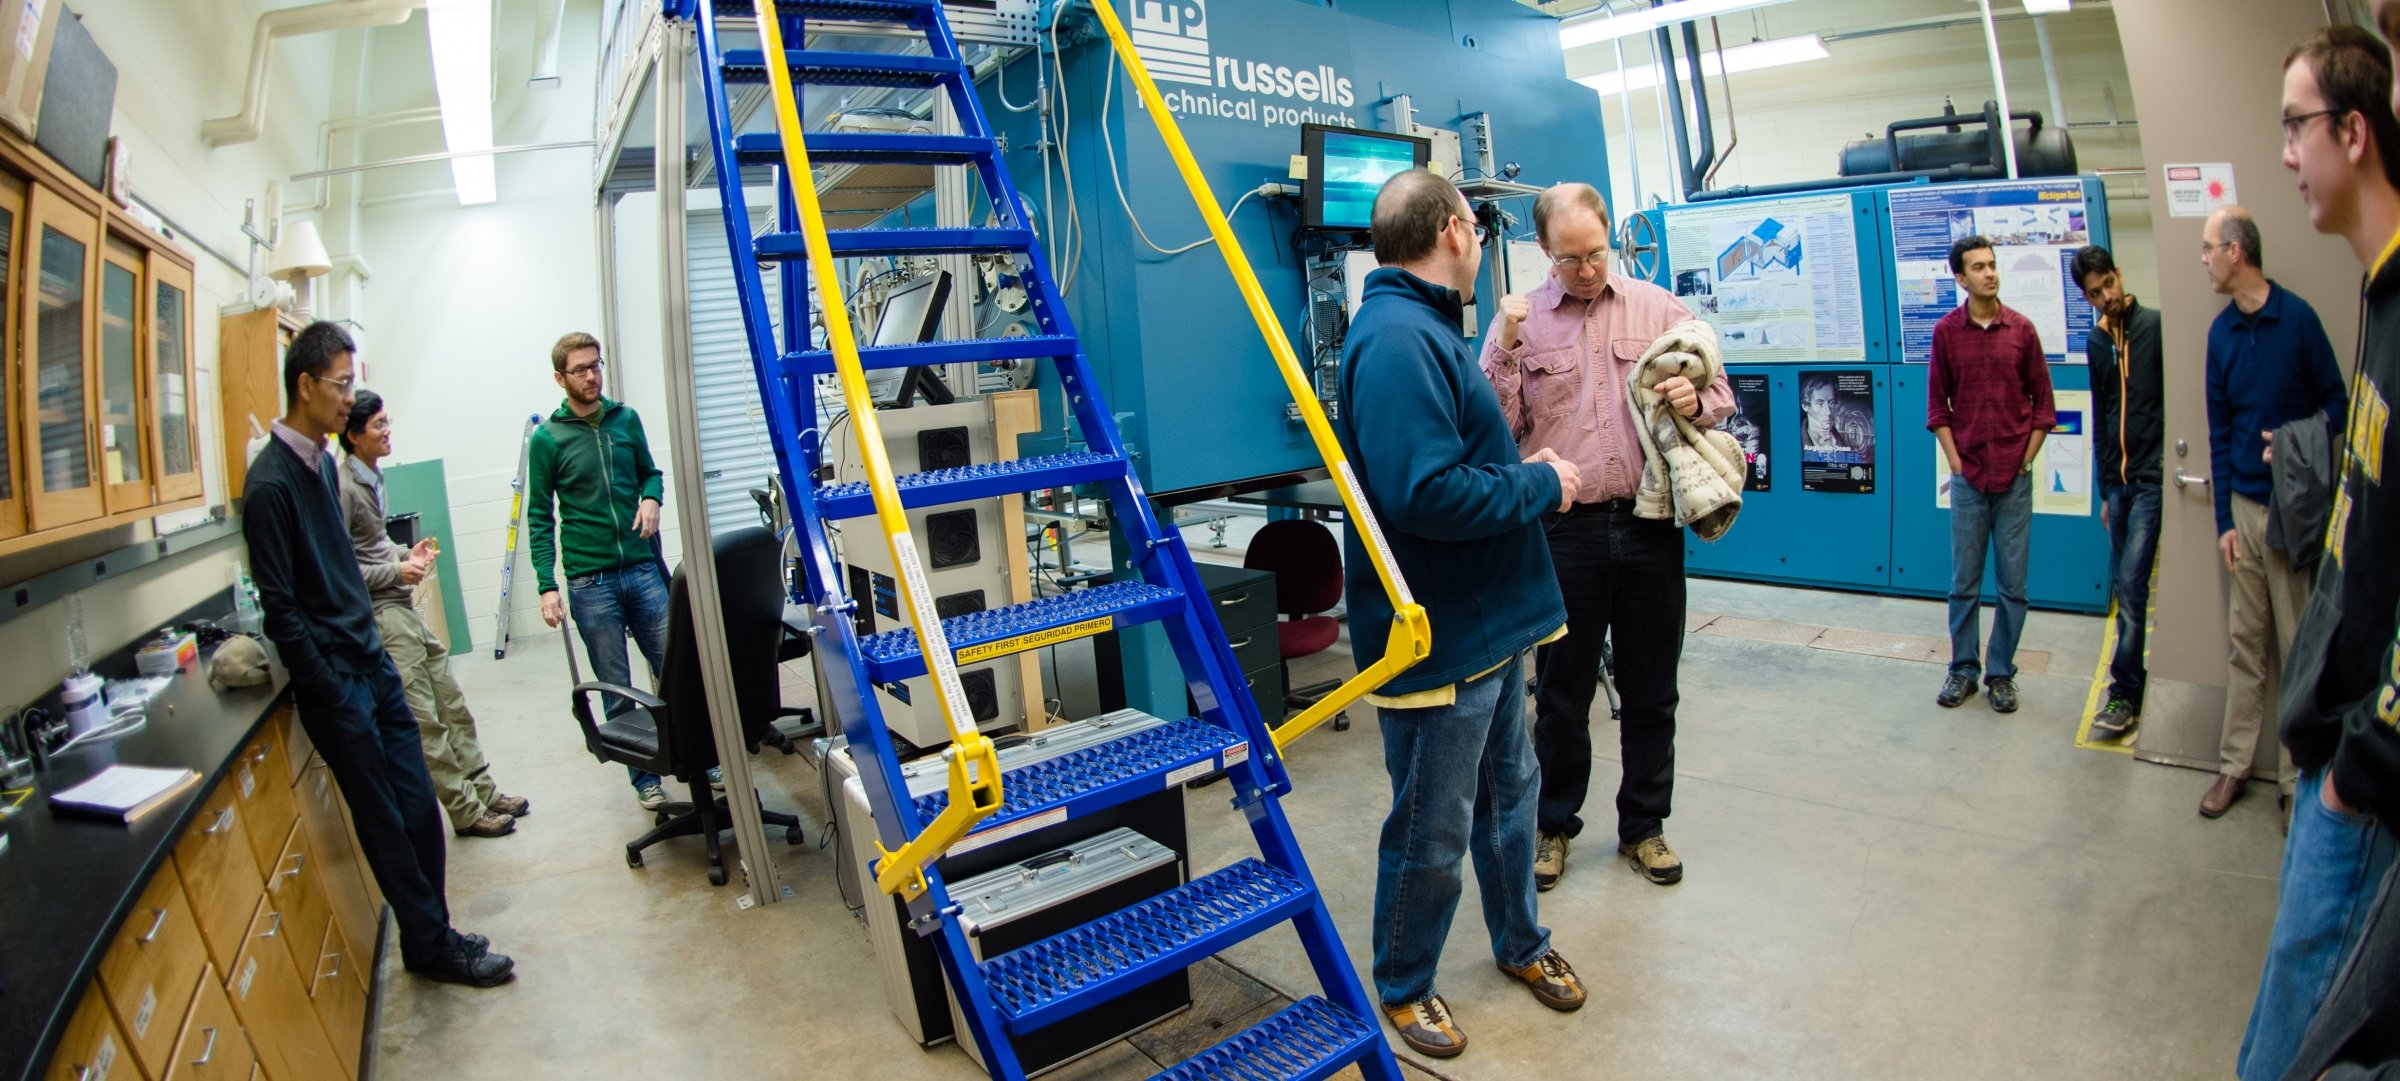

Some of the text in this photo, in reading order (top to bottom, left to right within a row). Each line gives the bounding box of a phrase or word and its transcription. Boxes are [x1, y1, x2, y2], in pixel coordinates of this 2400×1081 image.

[1215, 56, 1354, 108] russells
[1136, 88, 1256, 121] tchnical
[2038, 189, 2081, 201] Michigan Tech
[958, 644, 993, 659] SAFETY
[995, 639, 1020, 651] FIRST
[1023, 627, 1073, 645] SEGURIDAD
[1074, 618, 1111, 633] PRIMERO
